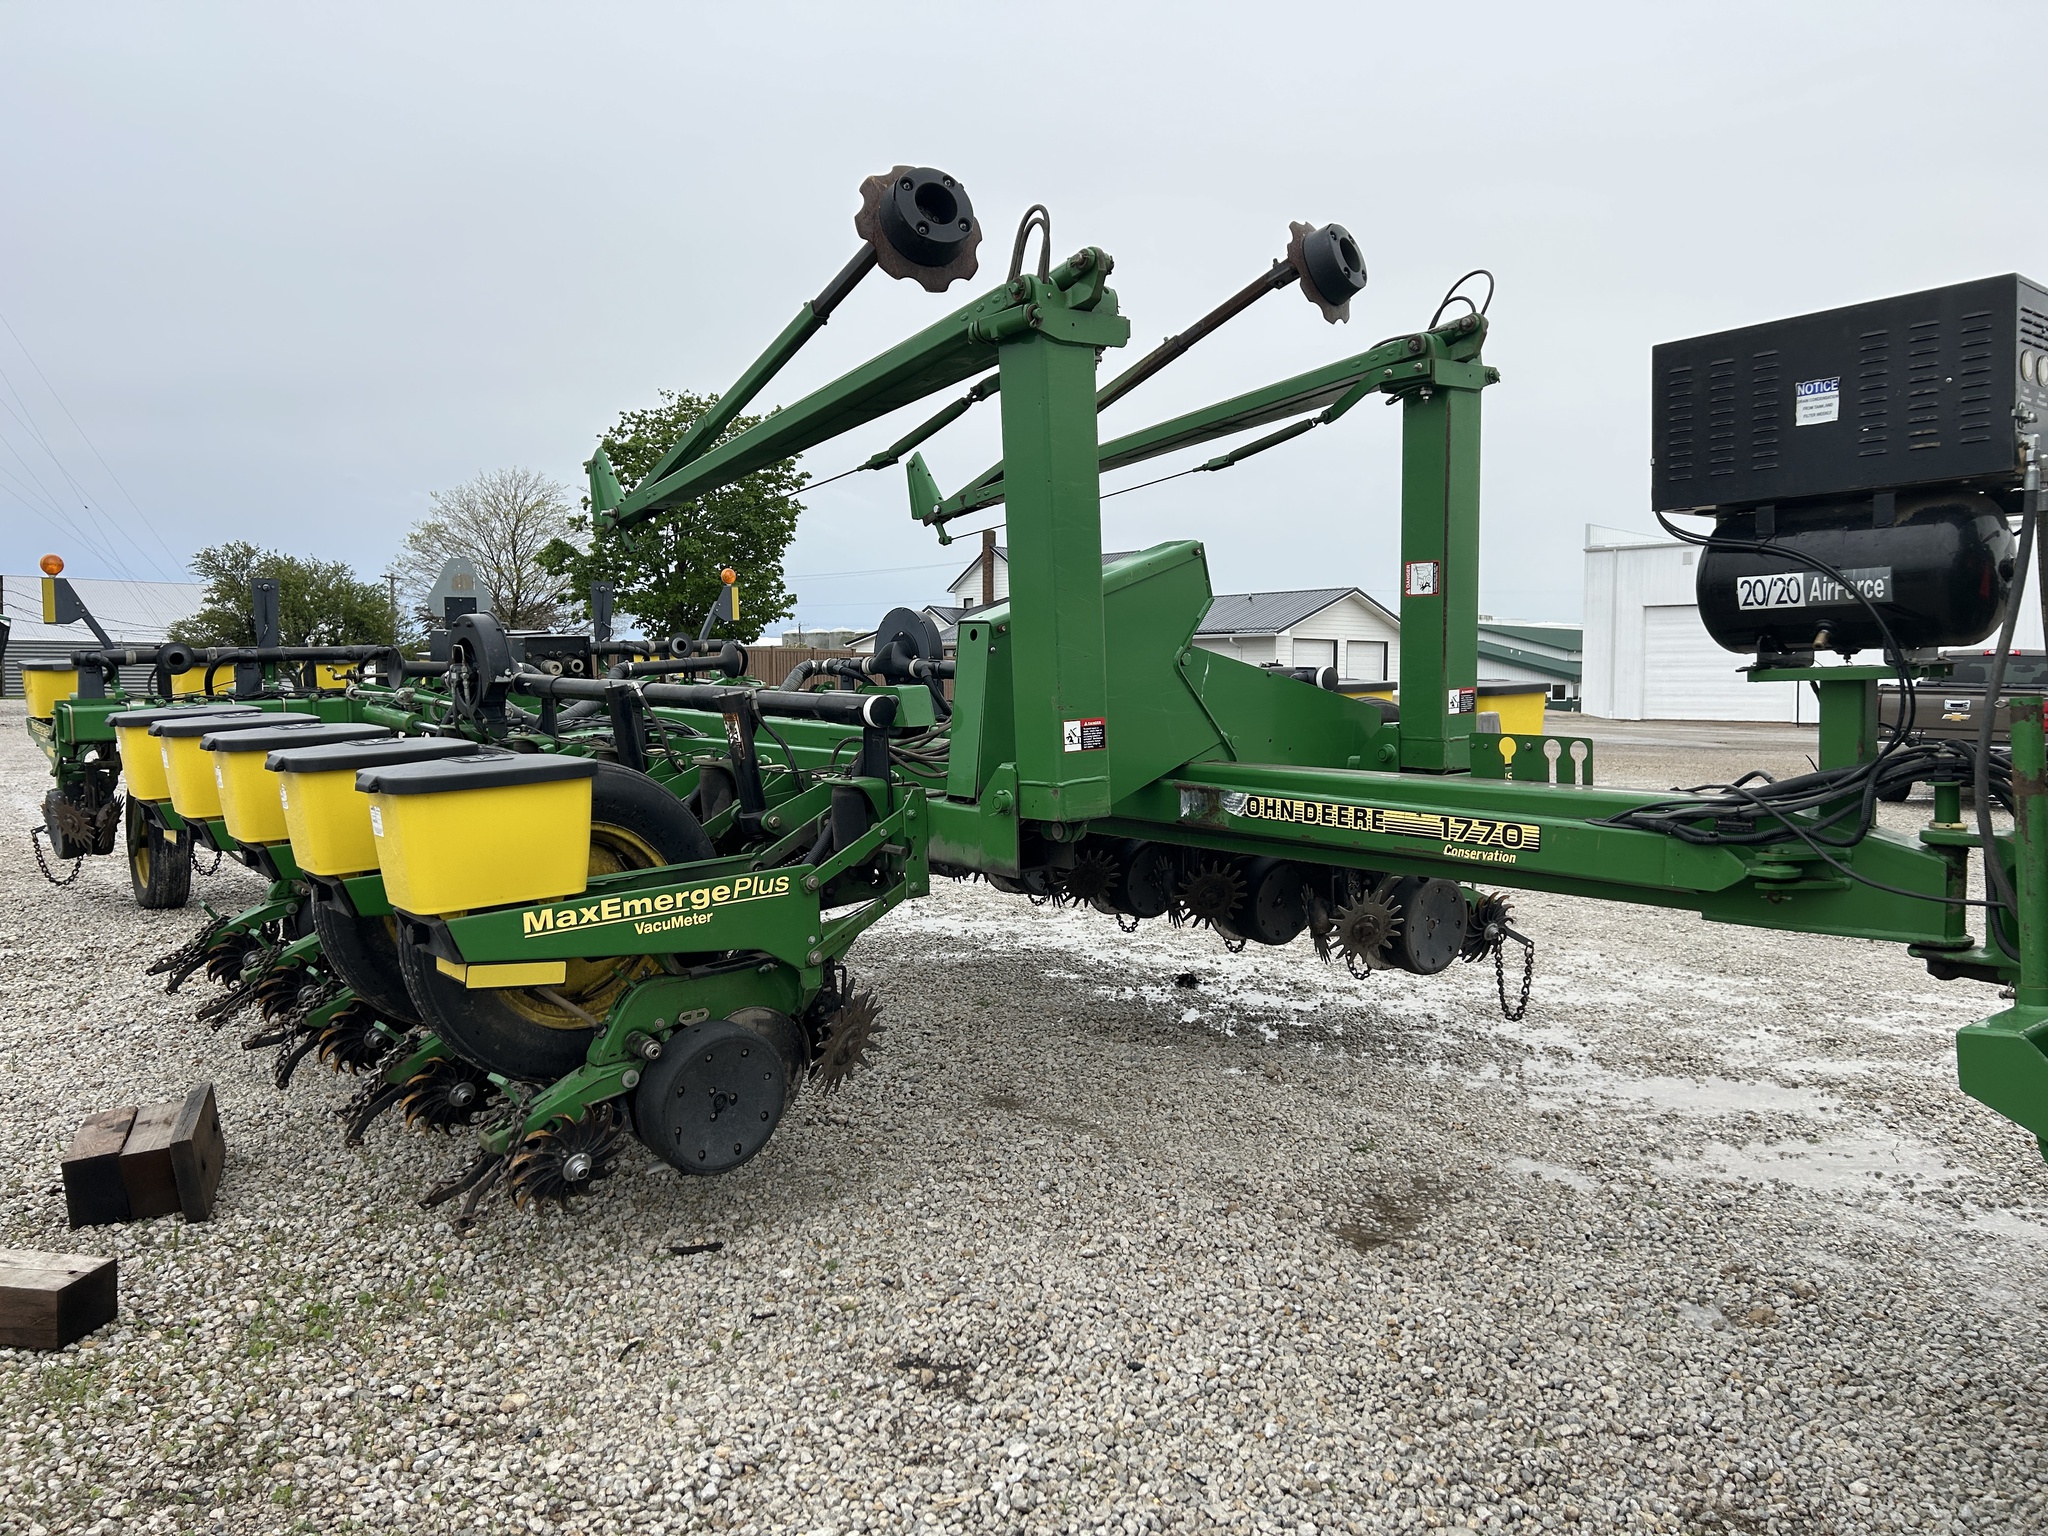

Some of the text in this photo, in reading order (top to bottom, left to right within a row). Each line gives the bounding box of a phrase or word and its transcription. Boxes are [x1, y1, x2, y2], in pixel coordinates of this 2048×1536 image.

[1797, 380, 1838, 396] NOTICE
[1740, 576, 1801, 607] 20/20
[1243, 795, 1387, 833] OHN DEERE
[1438, 815, 1526, 850] 1770
[1443, 843, 1517, 864] Conservation
[634, 911, 714, 936] VacuMeter
